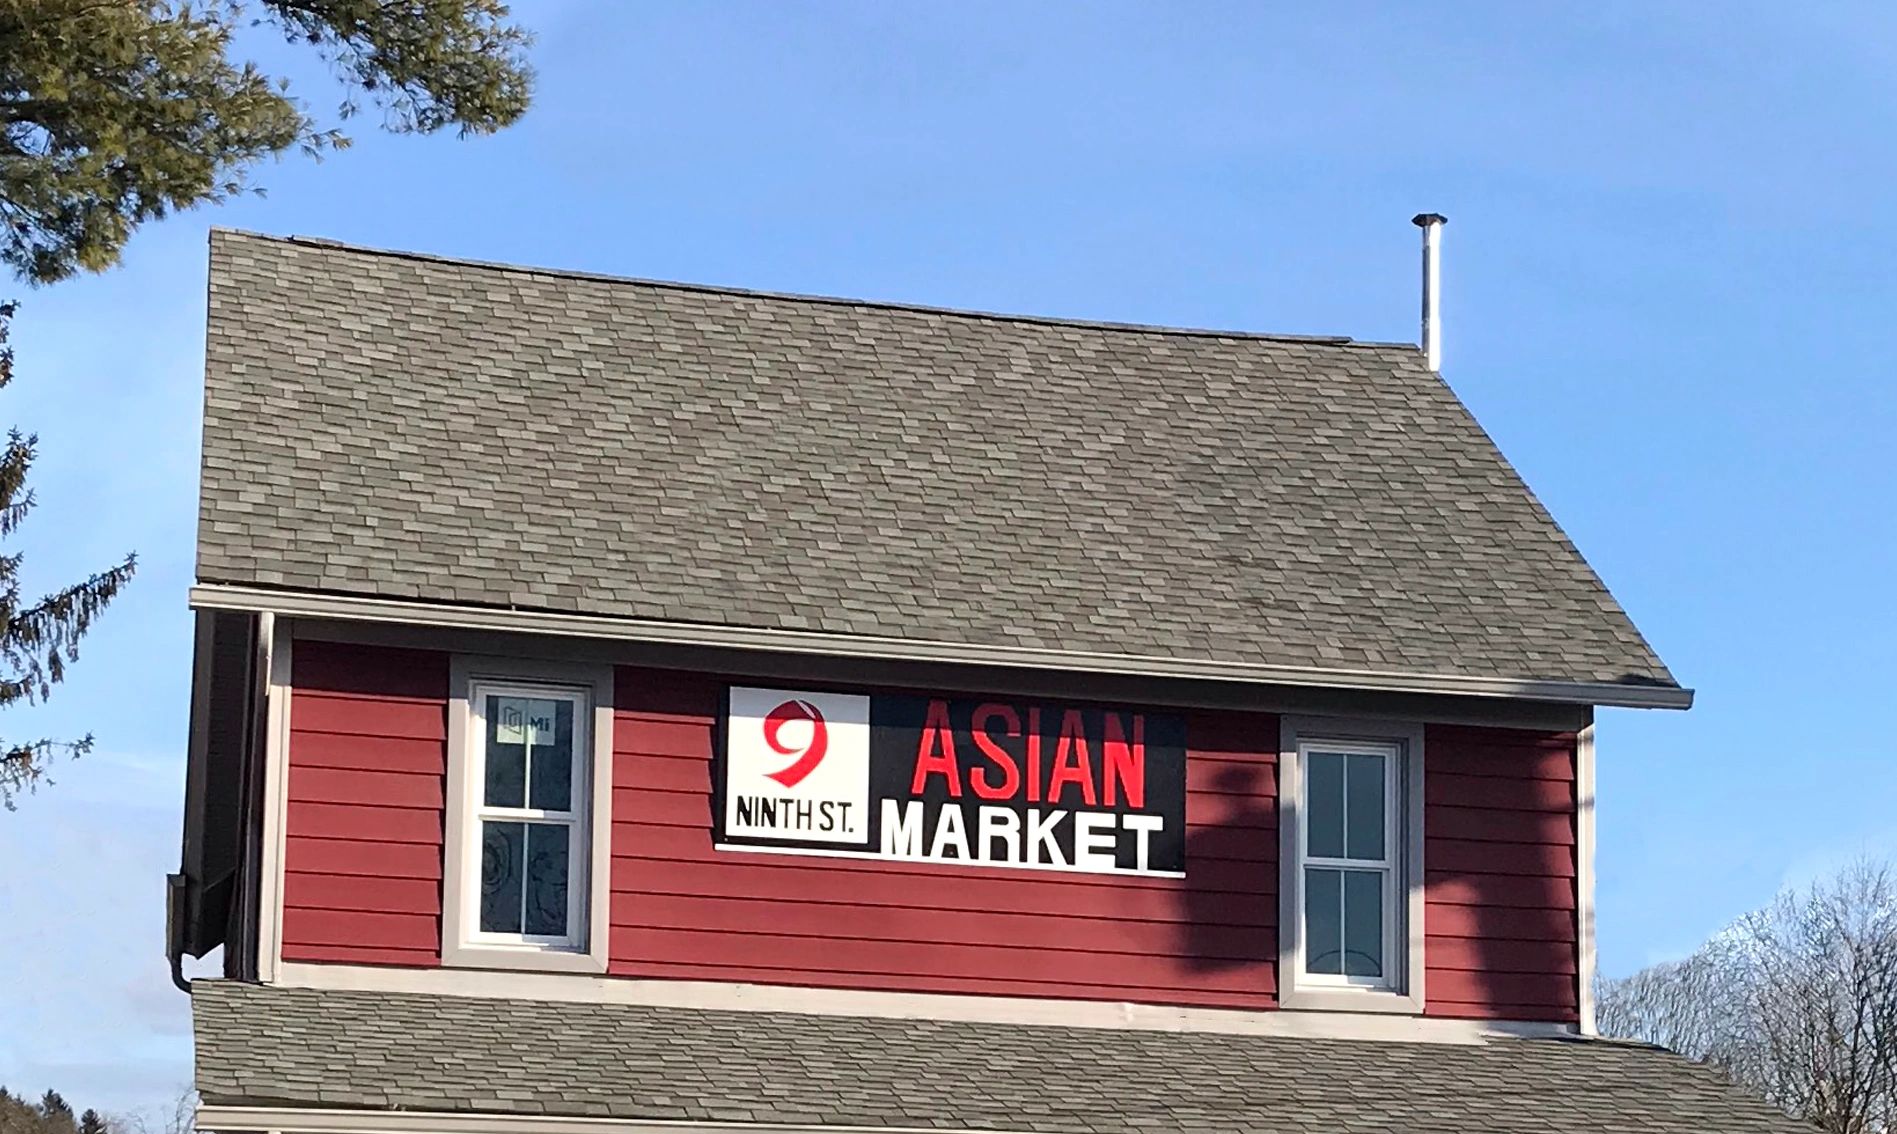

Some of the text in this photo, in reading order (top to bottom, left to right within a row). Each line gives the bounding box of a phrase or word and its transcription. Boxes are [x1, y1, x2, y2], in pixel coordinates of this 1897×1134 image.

[911, 699, 1146, 809] ASIAN
[736, 795, 854, 834] NINTH ST.
[880, 798, 1164, 871] MARKET
